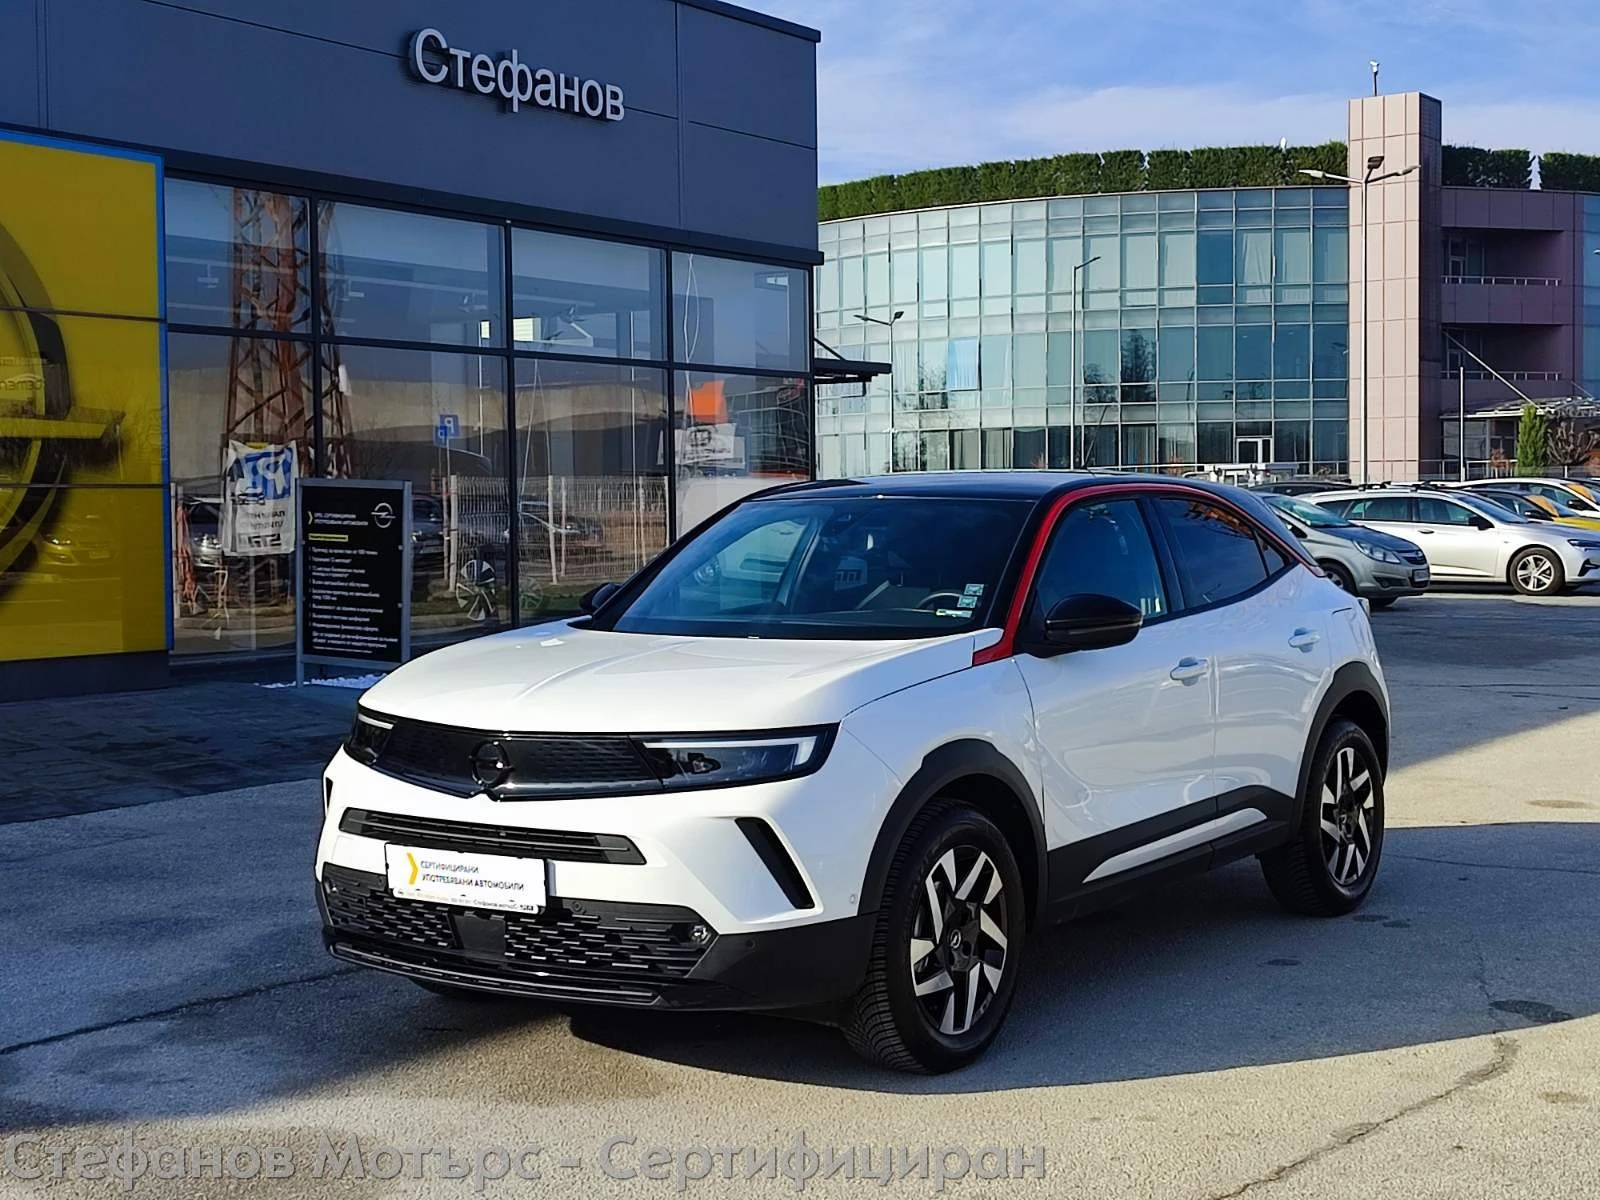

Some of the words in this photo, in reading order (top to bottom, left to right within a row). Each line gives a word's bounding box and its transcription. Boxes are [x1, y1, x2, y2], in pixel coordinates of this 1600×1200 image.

[412, 28, 625, 121] Стефанов
[420, 860, 480, 874] СЕРТИФИЦИРАНИ
[474, 879, 525, 891] АВТОМОБИЛИ
